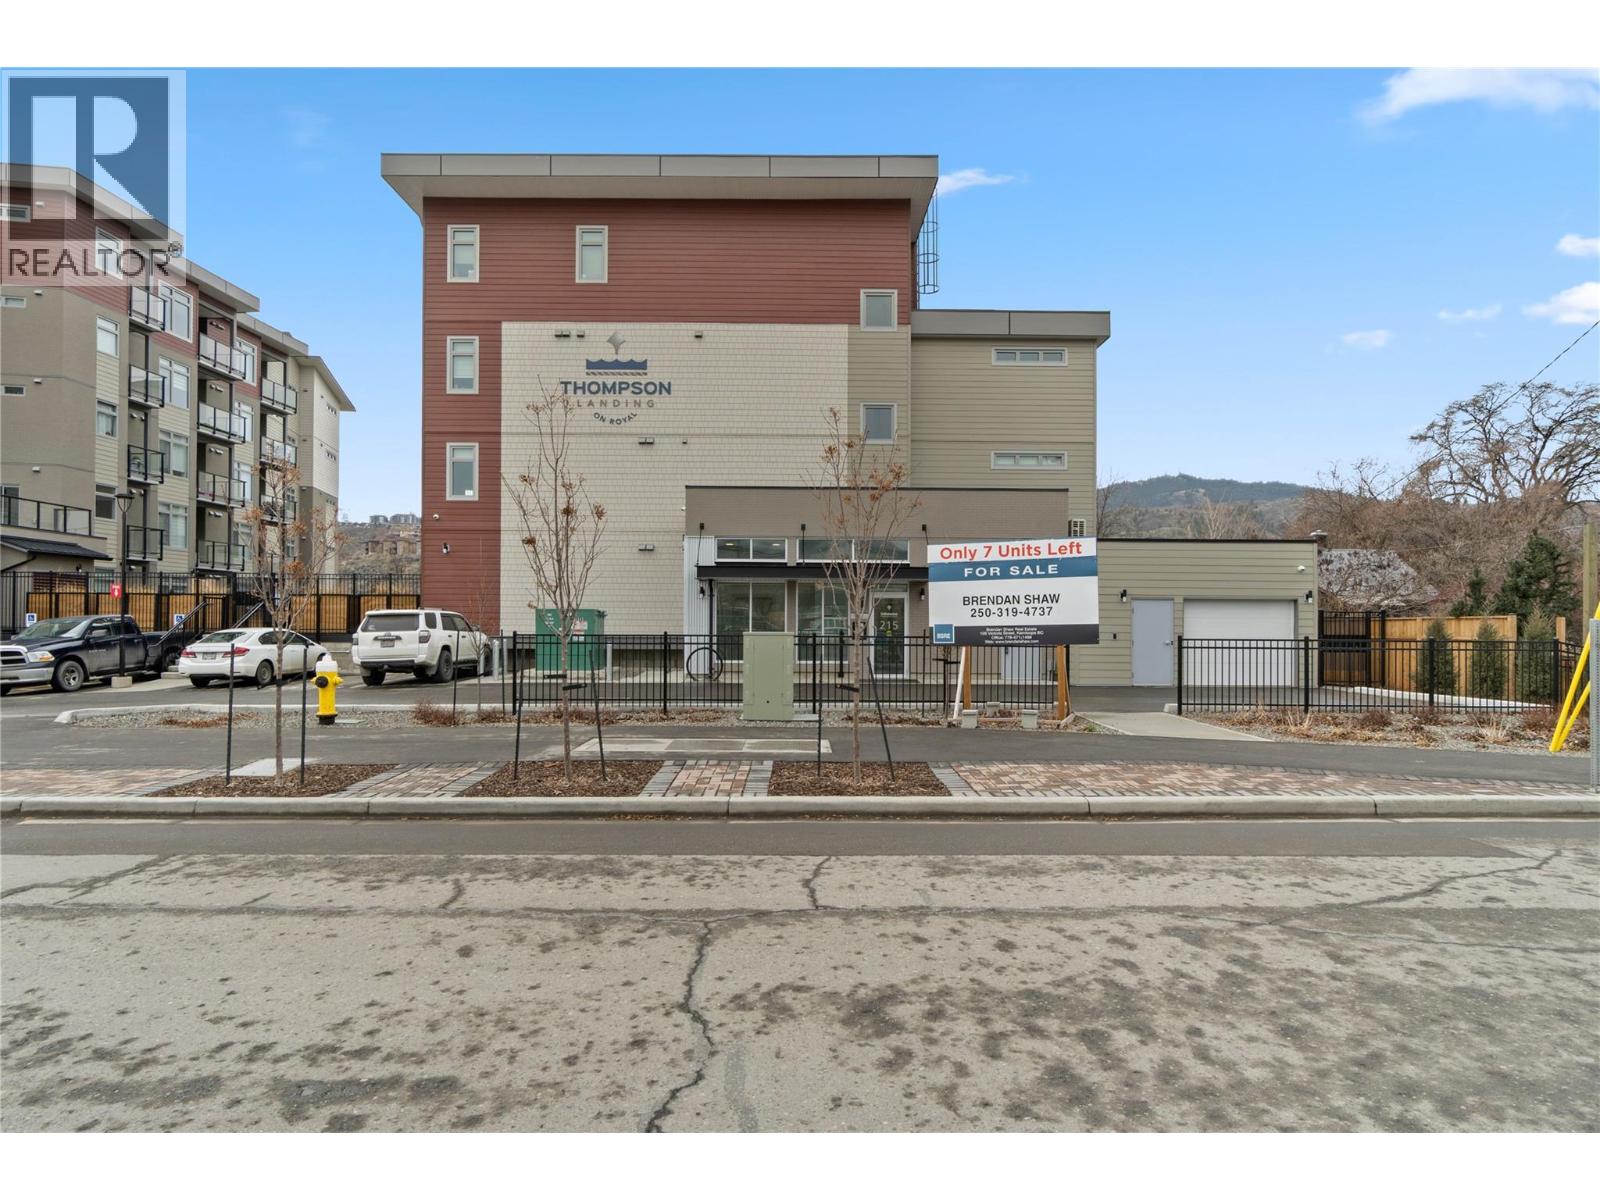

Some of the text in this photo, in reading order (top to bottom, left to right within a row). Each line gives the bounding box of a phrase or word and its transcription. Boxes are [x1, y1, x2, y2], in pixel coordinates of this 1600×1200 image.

[560, 381, 672, 396] THOMPSON
[577, 399, 655, 408] LANDING
[593, 411, 638, 426] ON ROYAL
[940, 541, 1083, 561] Only 7 Units Left
[964, 564, 1059, 578] FOR SALE
[962, 593, 1060, 606] BRENDAN SHAW
[970, 606, 1053, 618] 250-319-4737
[879, 620, 899, 631] 215
